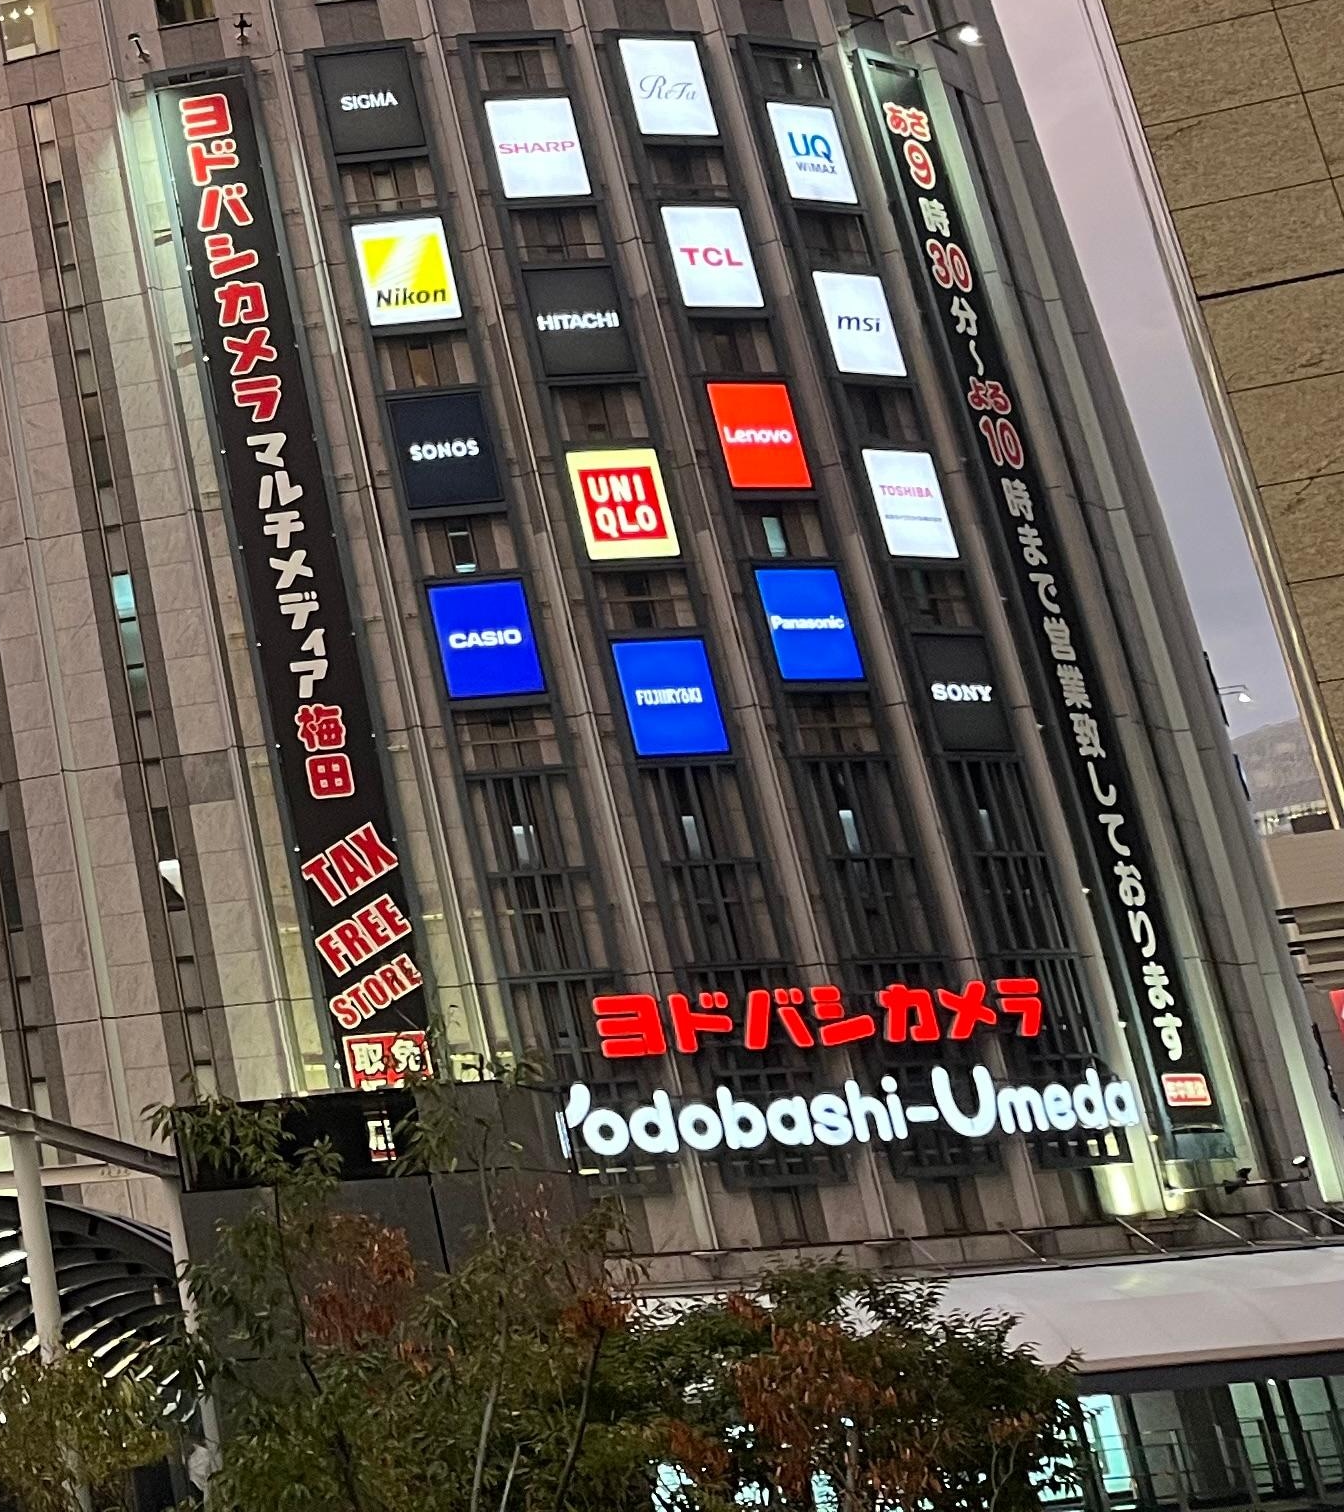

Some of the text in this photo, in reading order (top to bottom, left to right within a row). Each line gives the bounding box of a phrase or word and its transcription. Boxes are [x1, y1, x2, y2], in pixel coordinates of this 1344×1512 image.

[340, 90, 399, 112] SIGMA
[498, 140, 575, 155] SHARP
[786, 130, 832, 162] UQ
[679, 246, 744, 267] TCL
[375, 286, 447, 308] Nikon
[536, 311, 620, 332] HITACHI
[836, 314, 881, 333] msi
[724, 424, 792, 445] Lenovo
[409, 437, 480, 461] SONOS
[587, 474, 646, 504] UNI
[878, 484, 933, 498] TOSHIBA
[596, 504, 658, 539] QLO
[769, 614, 845, 632] Panasonic
[448, 628, 522, 650] CASIO
[931, 682, 993, 703] SONY
[302, 821, 399, 907] TAX
[315, 893, 412, 978] FREE
[329, 953, 424, 1029] STORE
[593, 977, 1042, 1058] ヨドバシカメラ
